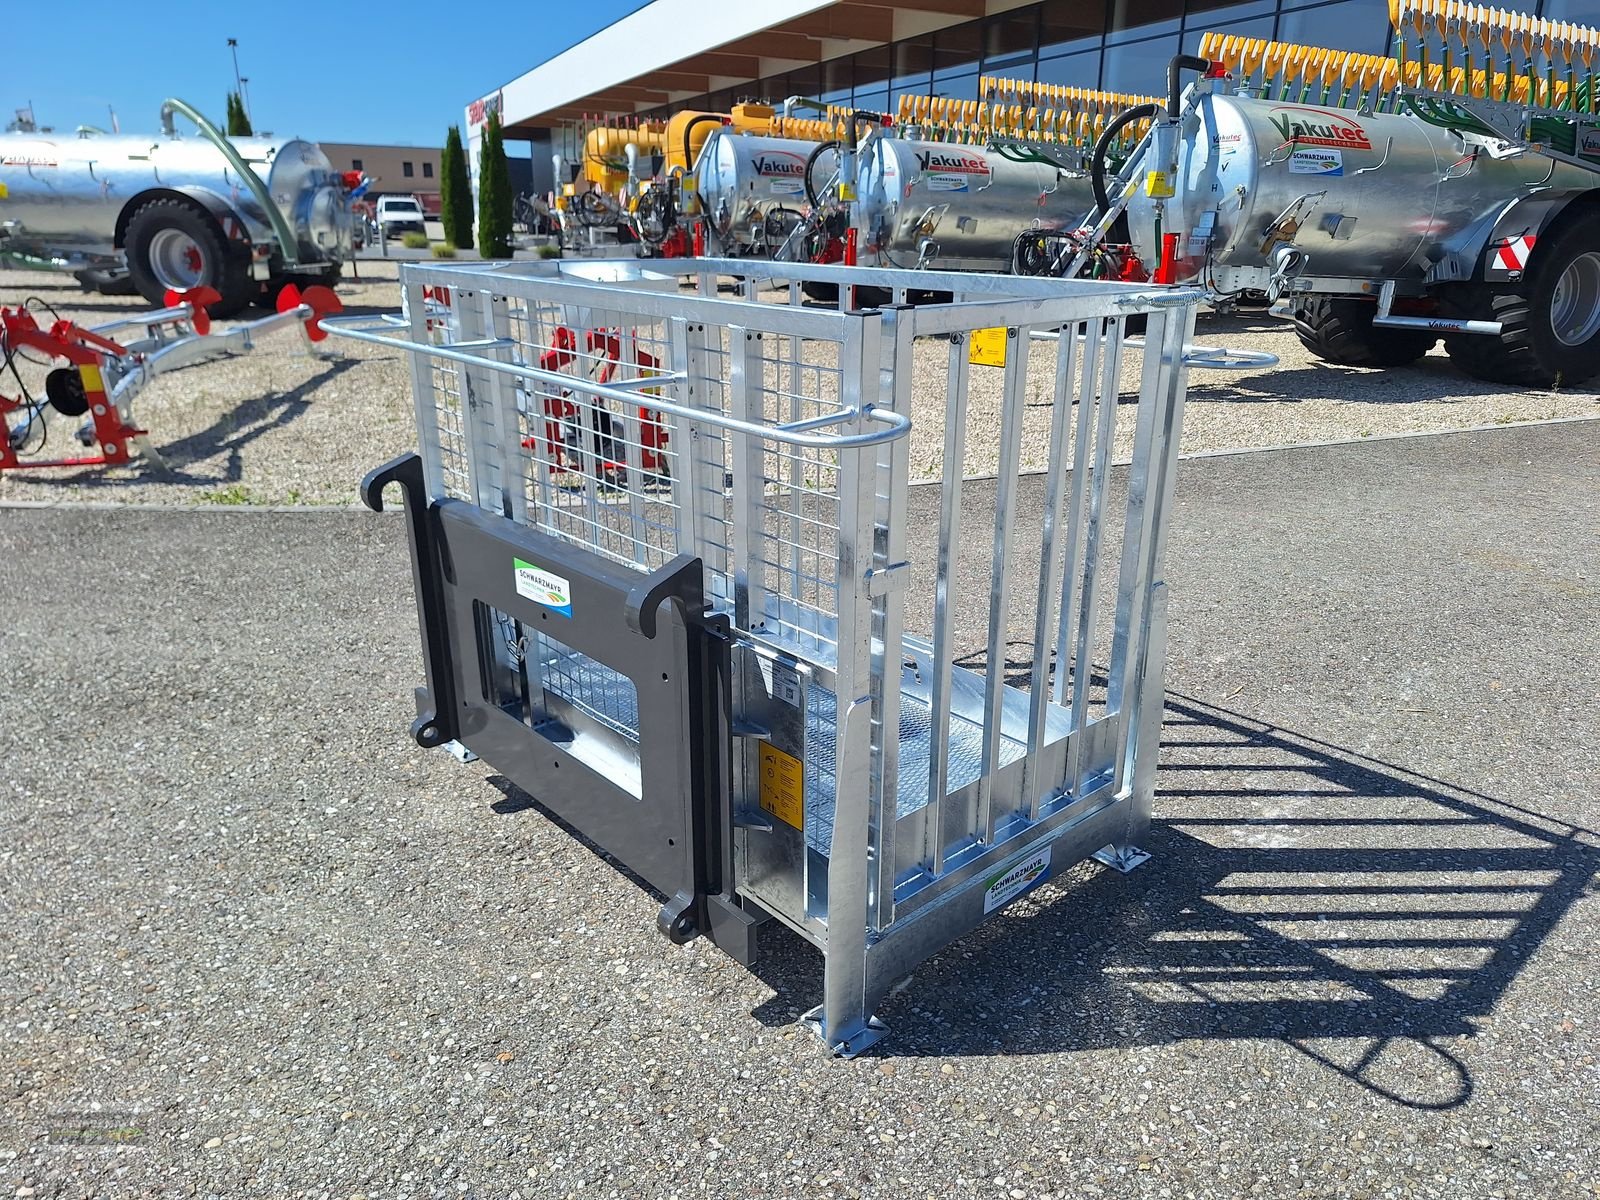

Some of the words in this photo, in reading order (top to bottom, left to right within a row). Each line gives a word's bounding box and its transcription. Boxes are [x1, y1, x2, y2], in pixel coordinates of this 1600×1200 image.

[1268, 113, 1369, 142] Vakutec
[751, 156, 805, 175] Vakute
[915, 151, 989, 171] Vakutec
[1293, 152, 1335, 161] SCHWARZMAYR
[1428, 320, 1460, 329] Vakutec
[519, 569, 562, 593] SCHWARZMAYR
[990, 858, 1042, 893] SCHWARZMAYR
